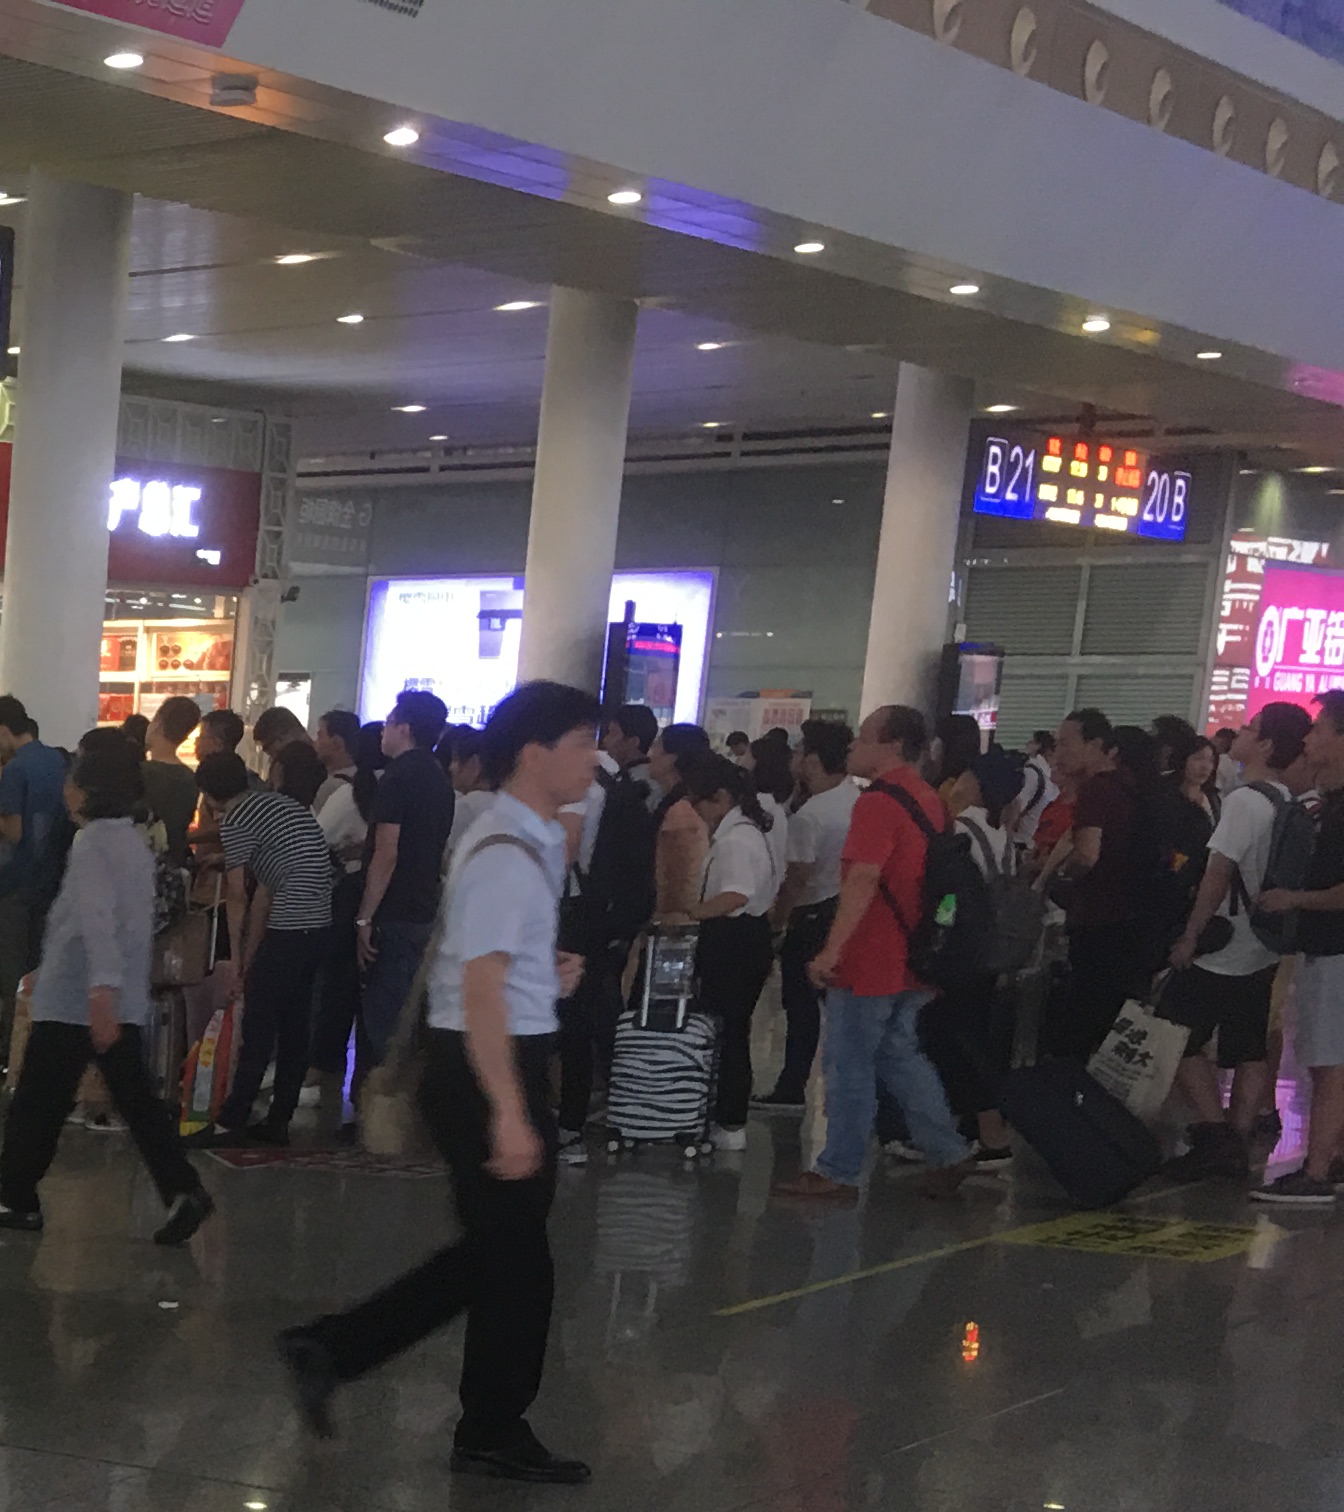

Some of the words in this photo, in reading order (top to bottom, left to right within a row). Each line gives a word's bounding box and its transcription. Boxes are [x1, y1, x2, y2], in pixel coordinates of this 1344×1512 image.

[984, 445, 1002, 494] B
[1005, 445, 1036, 502] 21
[1143, 470, 1169, 523] 20
[1171, 479, 1186, 522] B
